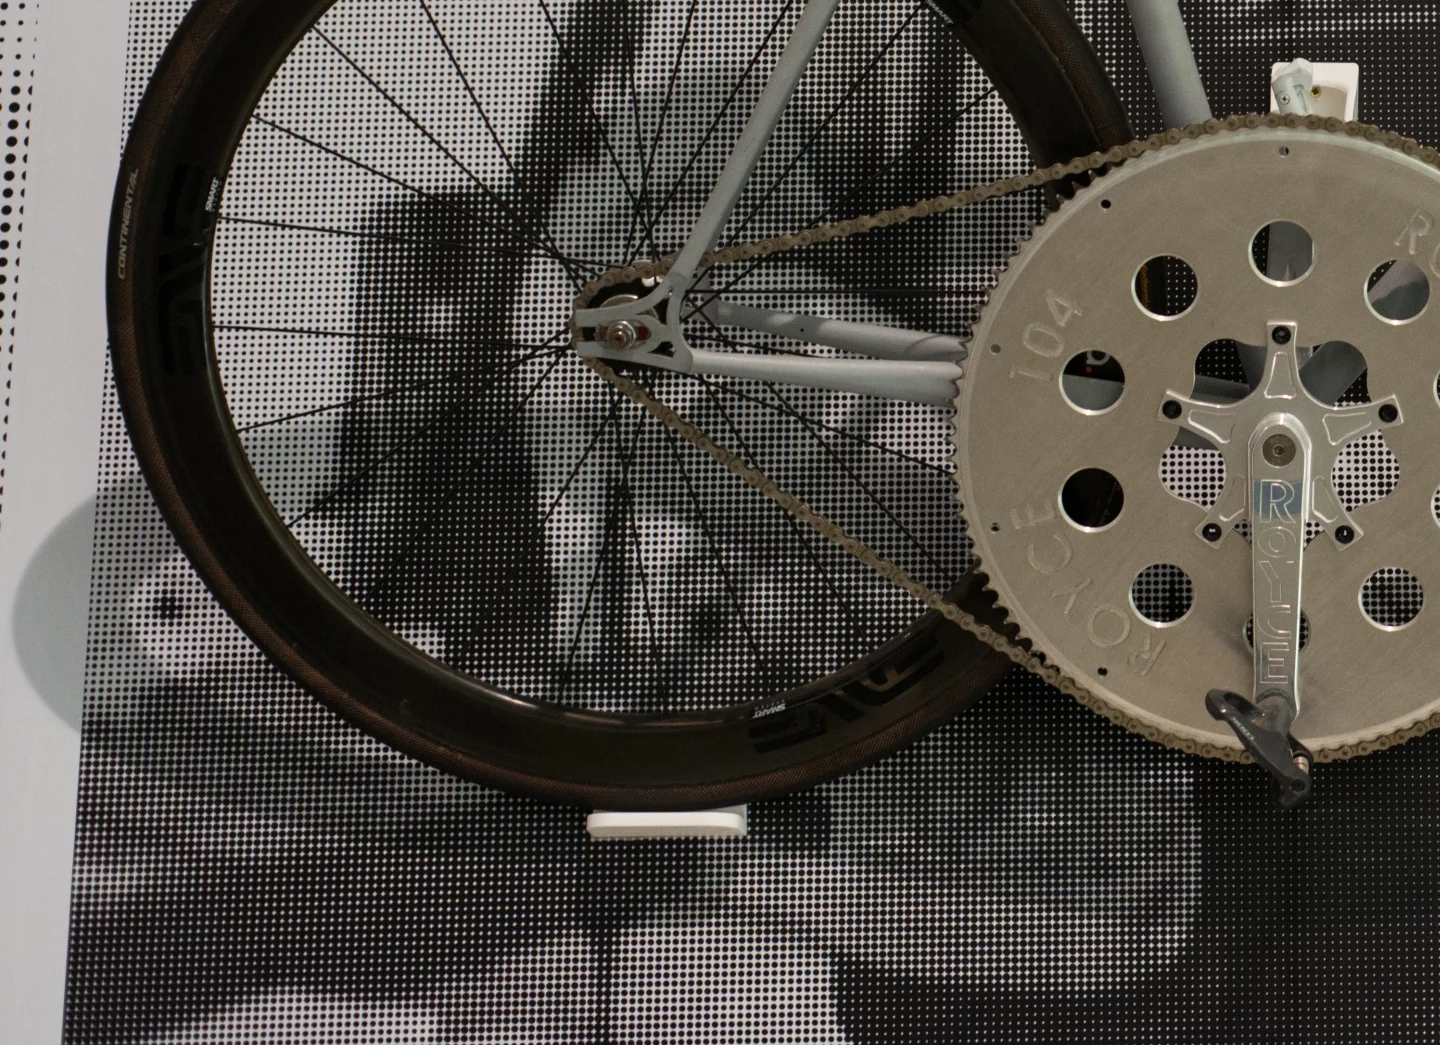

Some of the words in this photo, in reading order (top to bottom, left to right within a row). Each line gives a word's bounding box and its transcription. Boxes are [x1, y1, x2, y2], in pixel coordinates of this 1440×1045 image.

[117, 168, 139, 281] CONTINENTAL
[205, 176, 220, 213] SMART
[1009, 289, 1082, 381] 104
[1010, 503, 1168, 677] ROYCE
[1256, 478, 1298, 684] ROYCE
[752, 702, 786, 719] SMART
